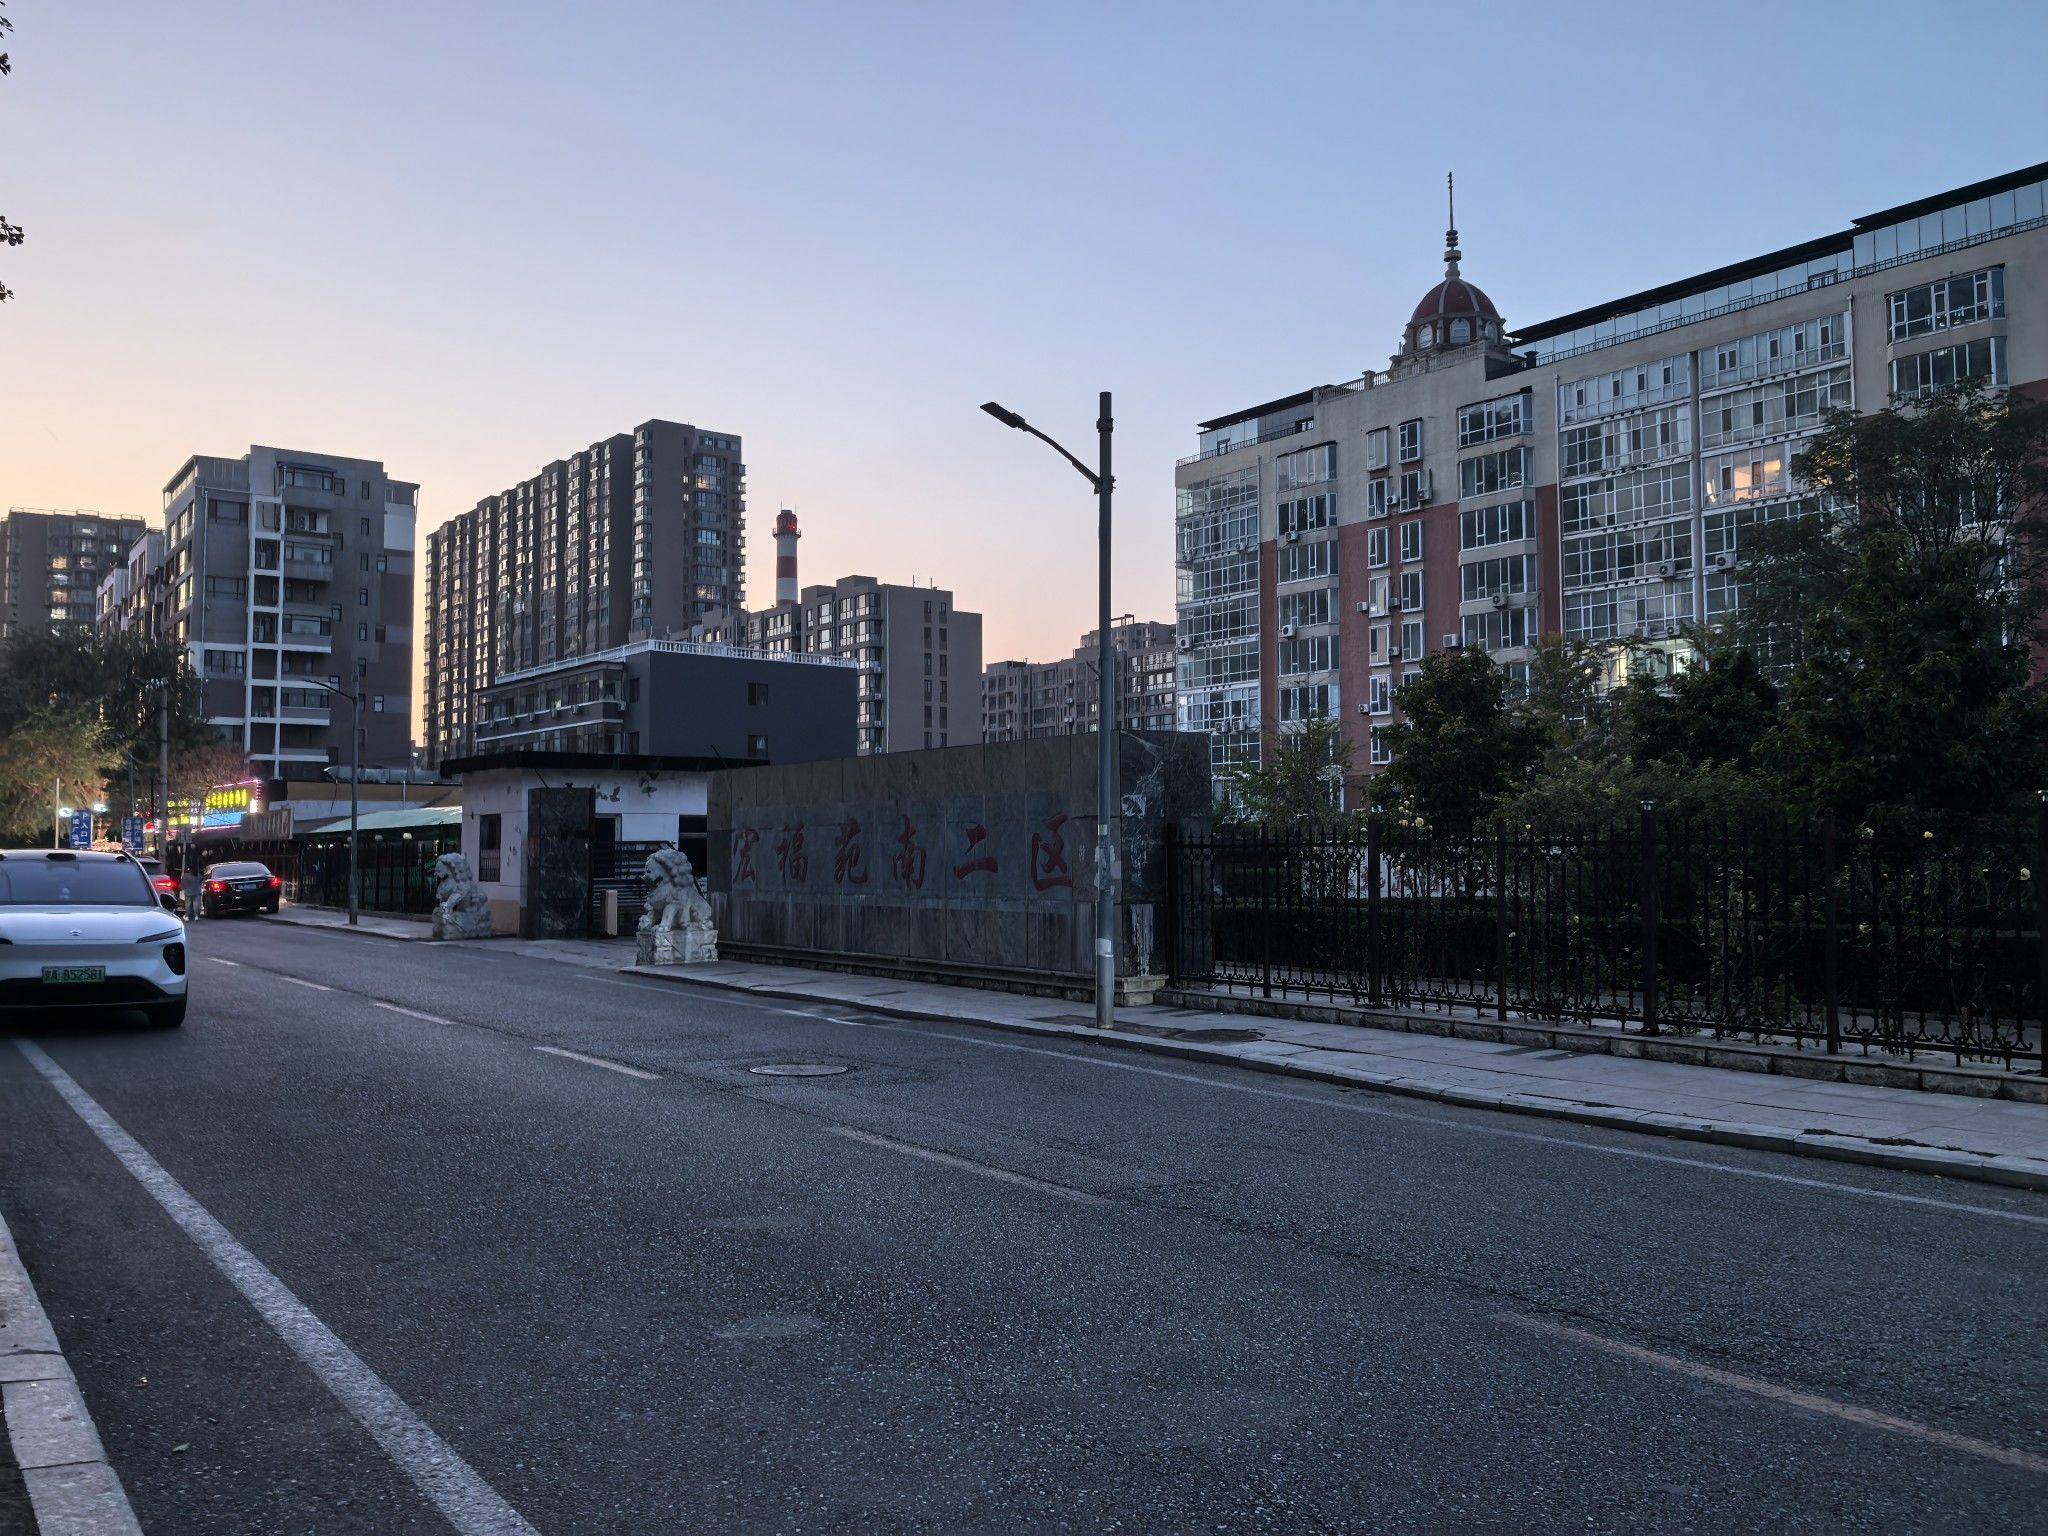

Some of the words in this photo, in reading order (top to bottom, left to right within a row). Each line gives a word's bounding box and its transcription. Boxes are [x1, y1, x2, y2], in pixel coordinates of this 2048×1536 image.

[732, 813, 1074, 892] 宏福苑南二区
